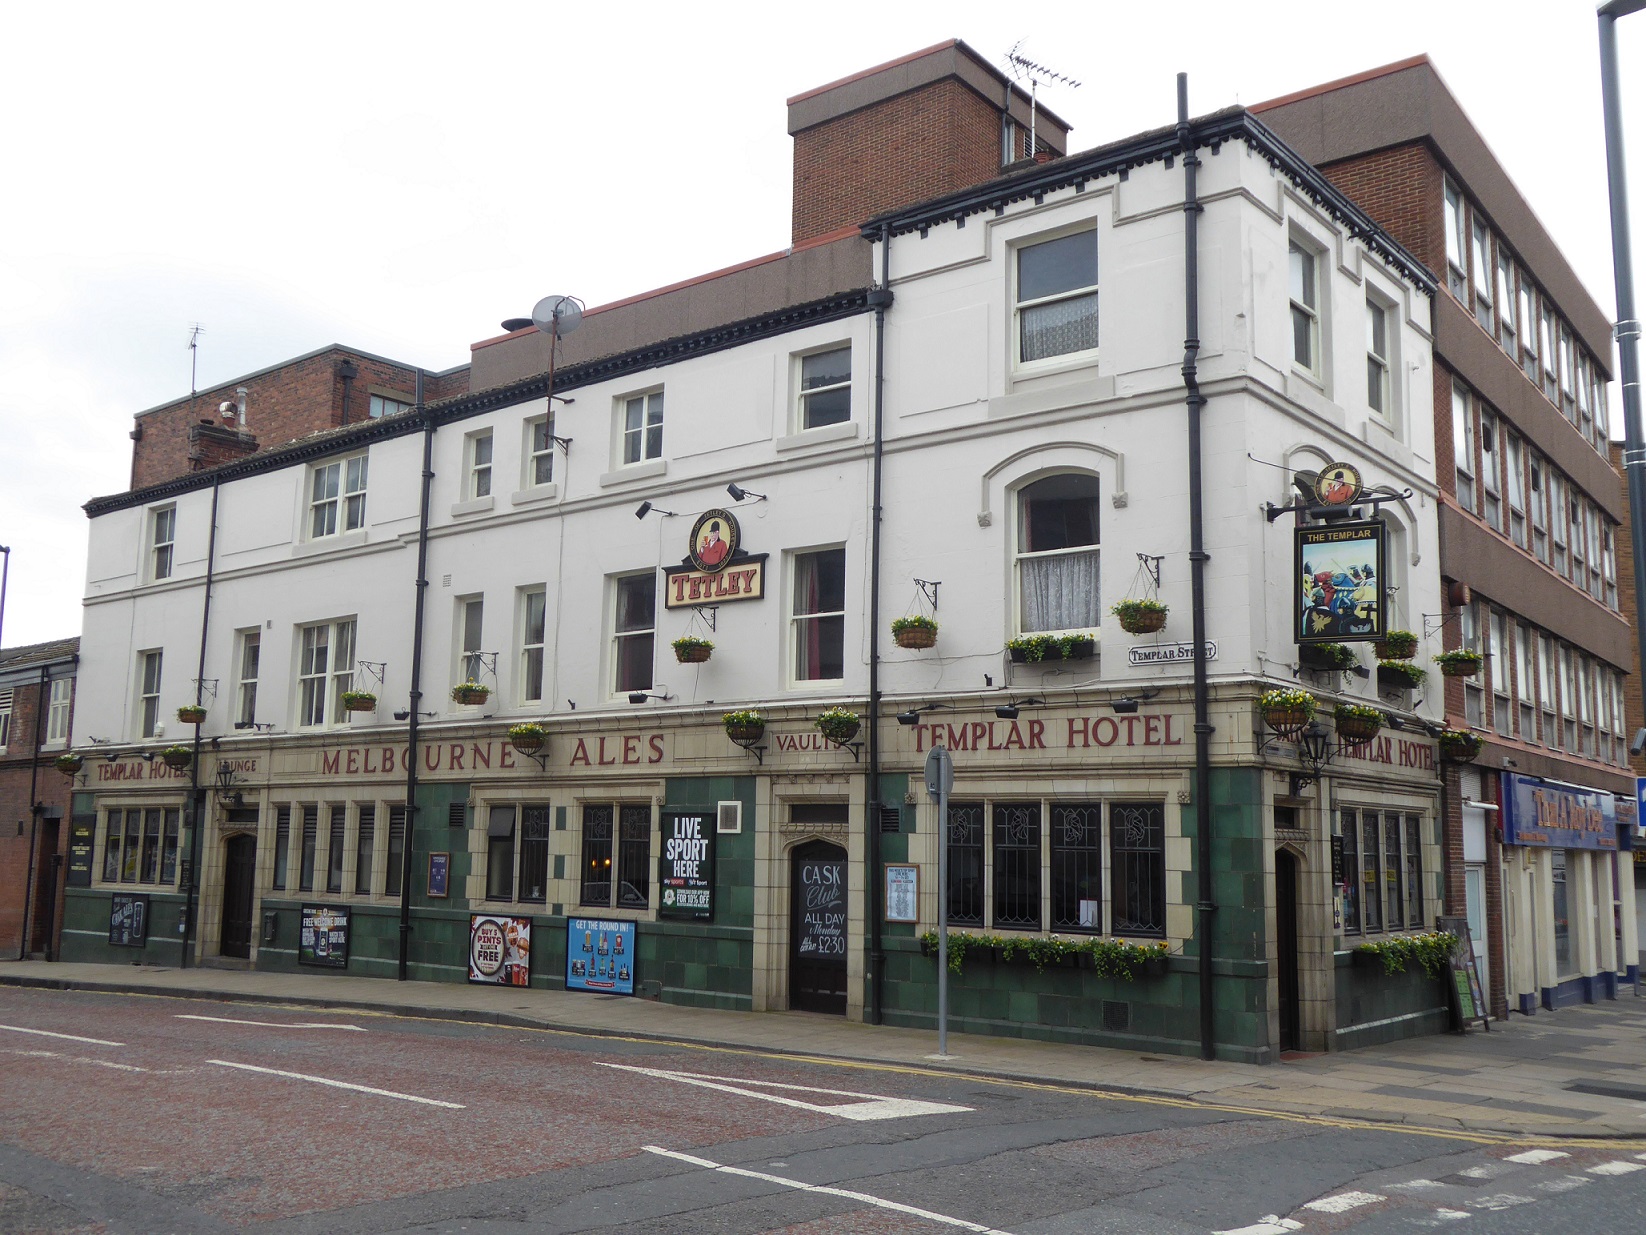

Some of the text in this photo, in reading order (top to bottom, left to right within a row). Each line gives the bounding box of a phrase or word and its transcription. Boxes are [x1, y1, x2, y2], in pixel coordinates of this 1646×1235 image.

[1307, 529, 1371, 542] THE TEMPLAR
[671, 569, 757, 601] TETLEY
[1131, 649, 1175, 661] TEMPLAR
[911, 714, 1182, 752] TEMPLAR HOTEL
[570, 734, 664, 766] ALES
[1397, 738, 1437, 771] HOTEL
[97, 761, 143, 781] TEMPLAR
[219, 760, 257, 773] LUNGE
[674, 817, 702, 839] LIVE
[666, 838, 709, 861] SPORT
[673, 860, 700, 878] HERE
[802, 865, 841, 885] CASK
[676, 894, 710, 904] FOR 10% OFF
[806, 884, 841, 908] Club
[303, 917, 314, 927] FREE
[313, 917, 334, 927] WELCOME
[576, 920, 629, 932] GET THE ROUND IN!
[804, 912, 845, 925] ALL DAY
[477, 935, 502, 945] PINTS
[477, 950, 499, 962] FREE
